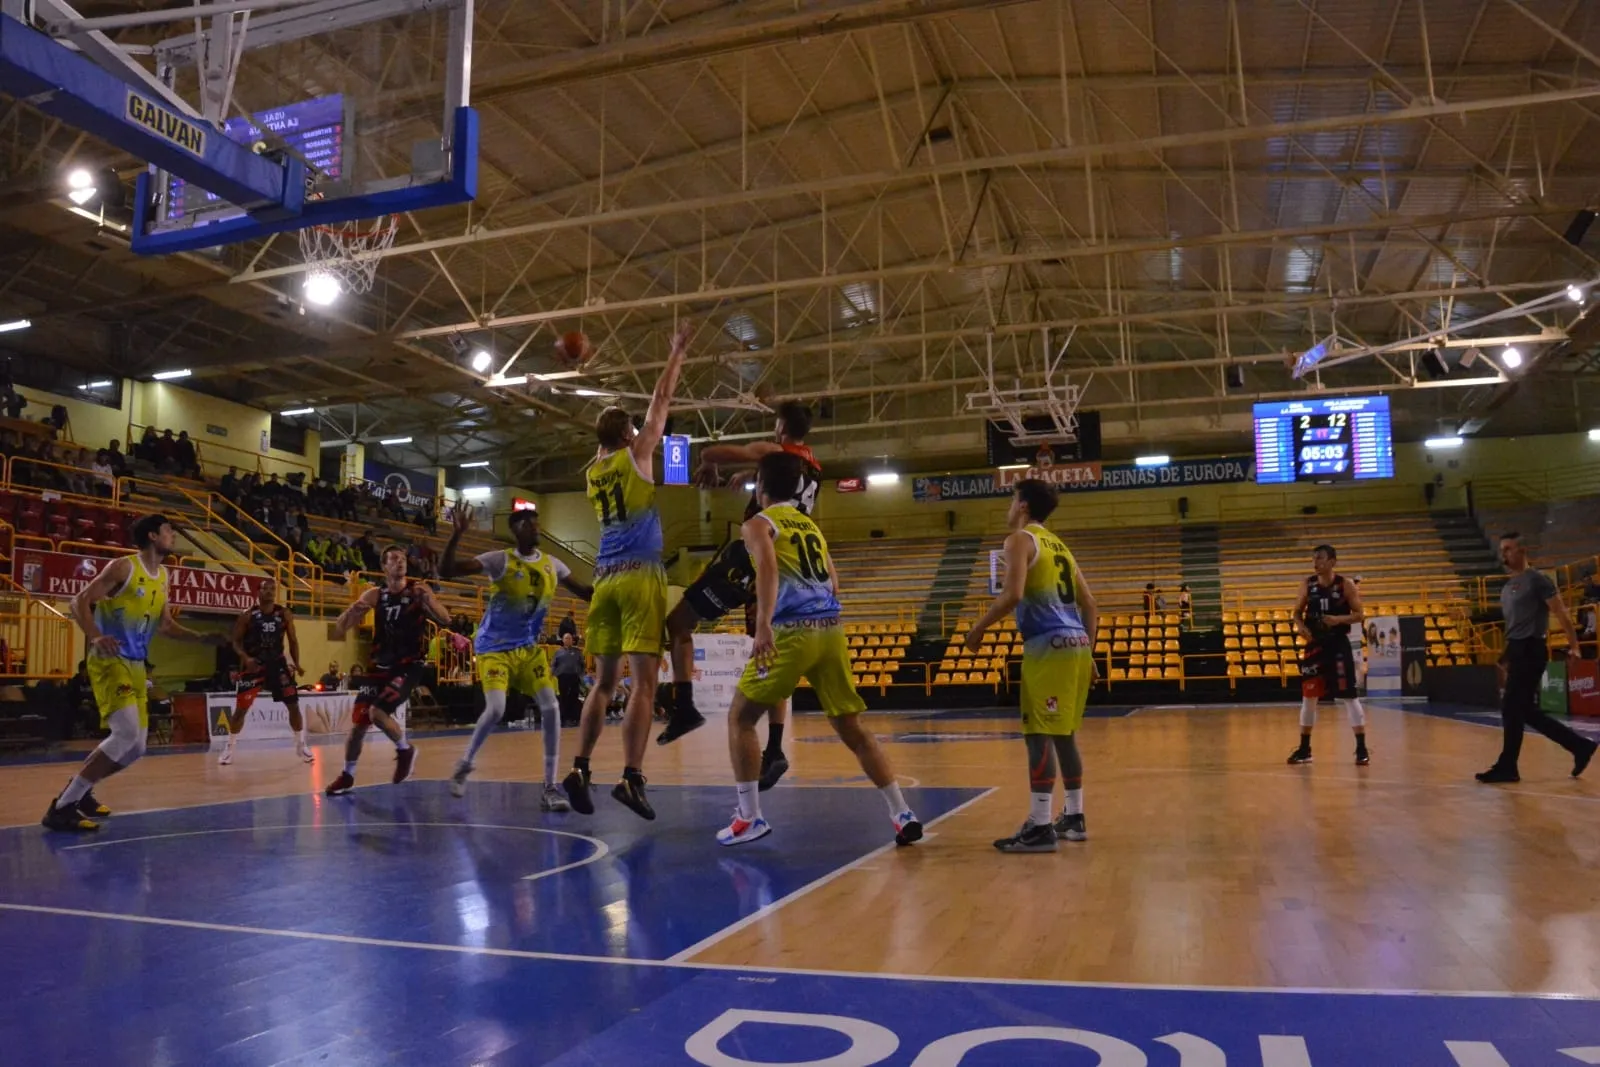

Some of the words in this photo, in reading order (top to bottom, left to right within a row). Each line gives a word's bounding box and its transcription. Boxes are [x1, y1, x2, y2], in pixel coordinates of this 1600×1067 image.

[129, 94, 202, 154] GALVAN
[1300, 415, 1311, 429] 2
[1328, 412, 1347, 428] 12
[672, 446, 681, 463] 8
[1302, 445, 1345, 461] 05:03
[1026, 464, 1095, 484] GACETA
[1102, 465, 1156, 487] REINAS
[1159, 467, 1181, 484] DE
[1187, 461, 1244, 482] EUROPA
[1304, 462, 1314, 474] 3
[1333, 460, 1344, 473] 4
[596, 481, 627, 527] 11
[790, 532, 830, 583] 16
[1053, 554, 1075, 605] 3
[174, 588, 193, 605] LA
[195, 590, 261, 610] HUMANIDA
[1320, 598, 1329, 611] 11
[385, 604, 402, 622] 77
[262, 621, 277, 633] 35
